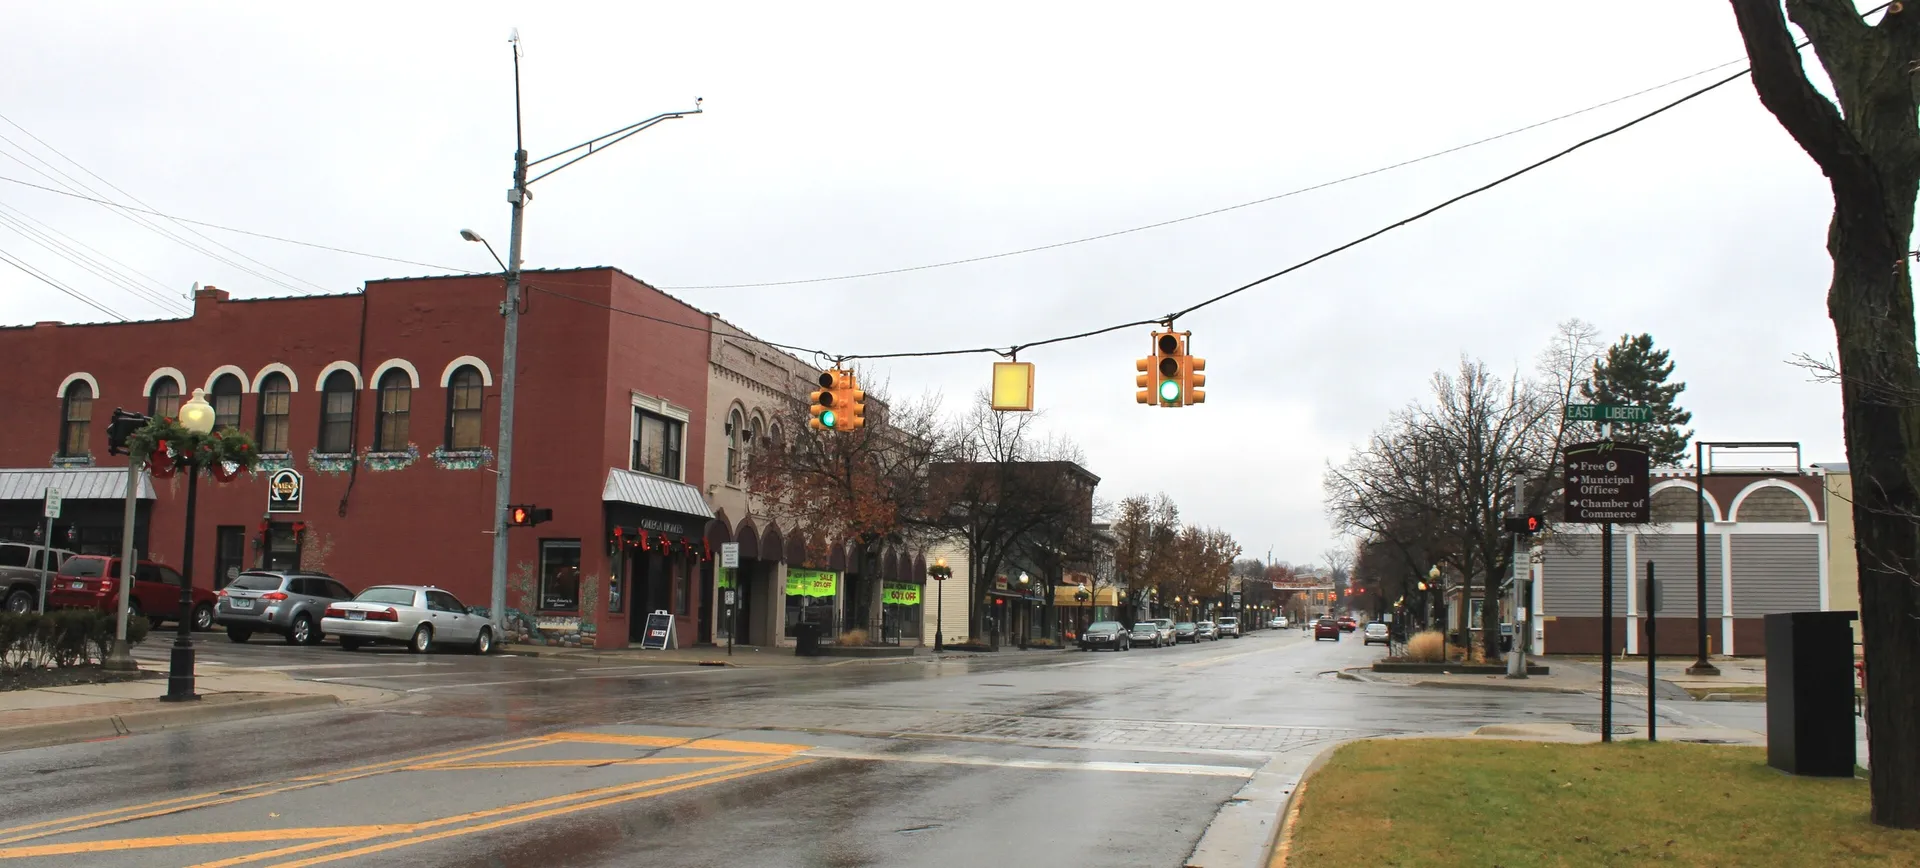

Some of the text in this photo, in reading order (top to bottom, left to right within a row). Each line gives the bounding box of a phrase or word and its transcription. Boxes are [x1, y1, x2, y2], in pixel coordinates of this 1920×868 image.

[1568, 406, 1648, 420] EAST LIBERTY
[1580, 462, 1605, 471] Free
[1580, 475, 1634, 485] Municipal
[1580, 485, 1619, 494] Offices
[1580, 498, 1644, 508] Chamber of
[1580, 509, 1637, 519] Commerce
[641, 518, 662, 530] OMEGA
[819, 573, 833, 582] SALE
[823, 581, 832, 589] OFF
[891, 590, 916, 601] 60% OFF
